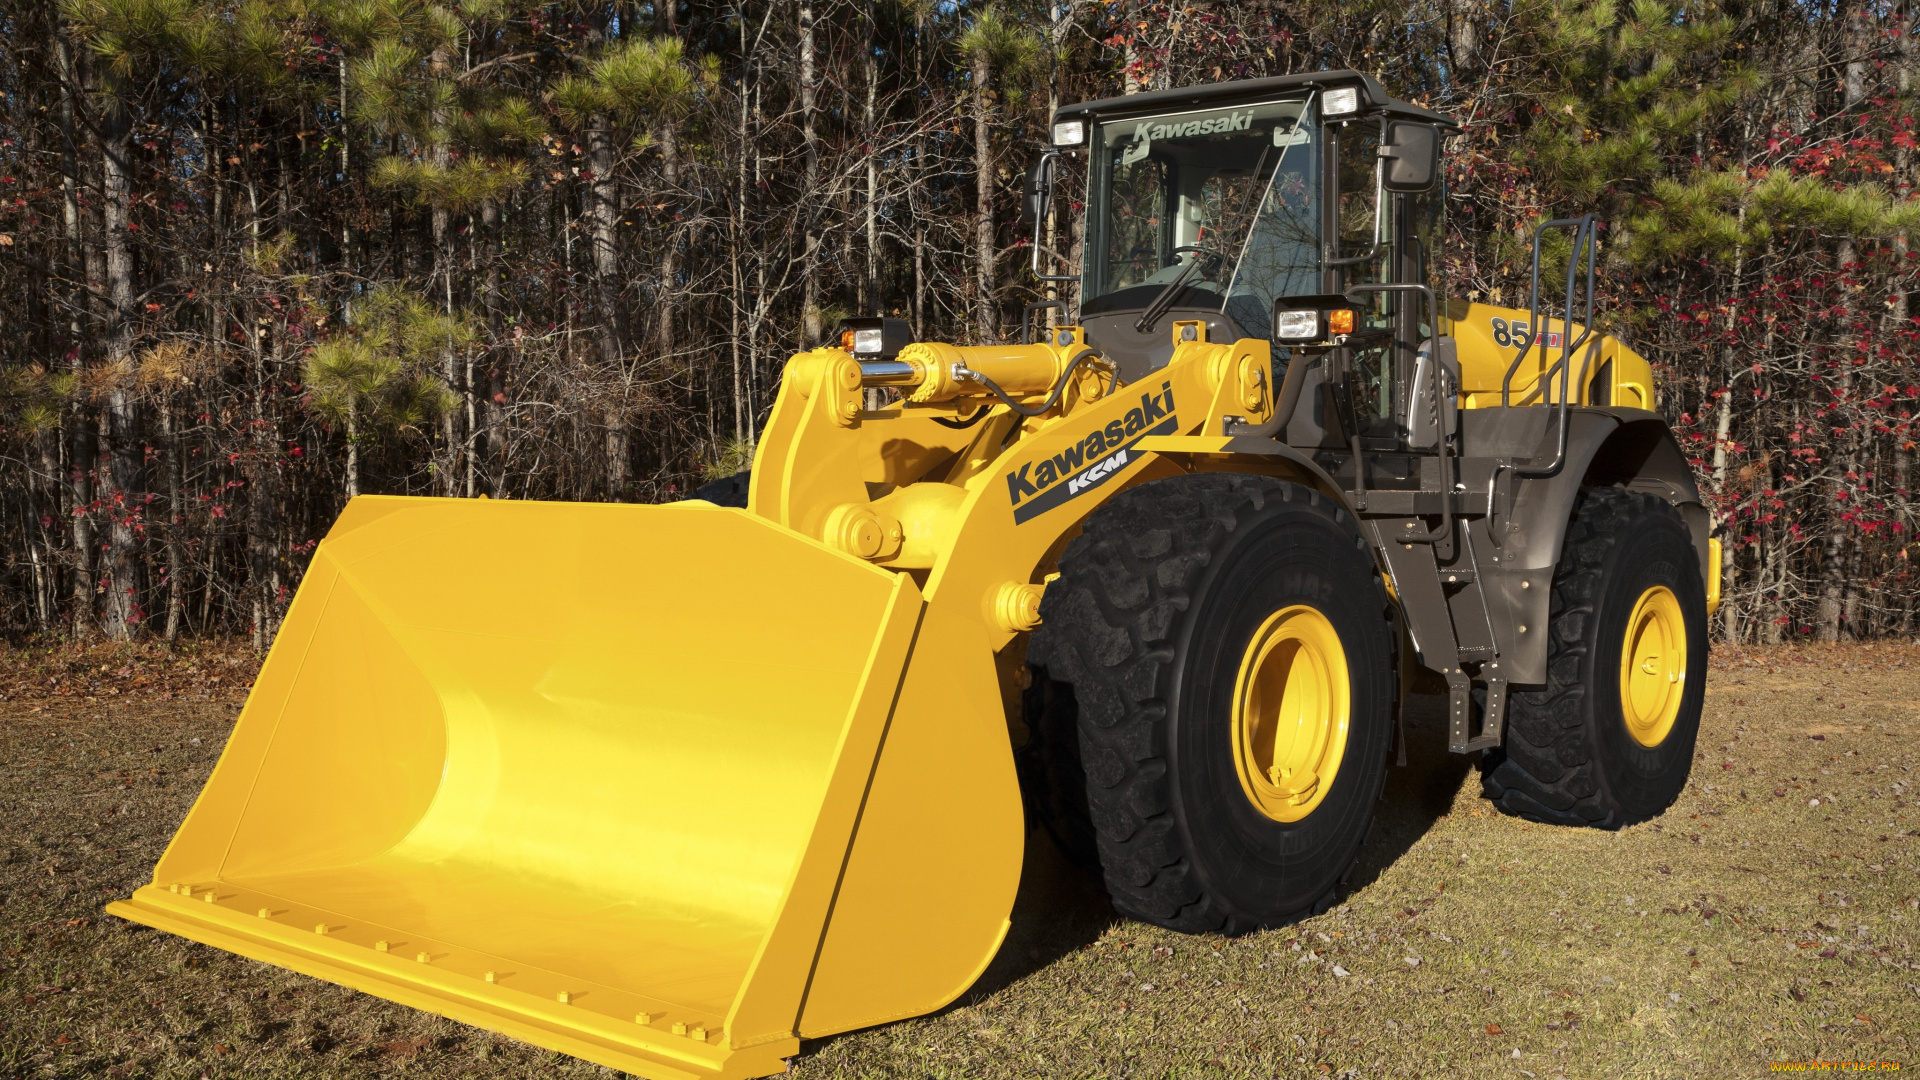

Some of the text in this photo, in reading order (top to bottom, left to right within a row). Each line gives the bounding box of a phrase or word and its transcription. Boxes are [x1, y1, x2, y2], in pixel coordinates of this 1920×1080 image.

[1132, 109, 1255, 143] Kawasaki
[1490, 316, 1531, 351] 85
[1006, 380, 1176, 506] Kawasaki
[1068, 448, 1128, 495] KCM
